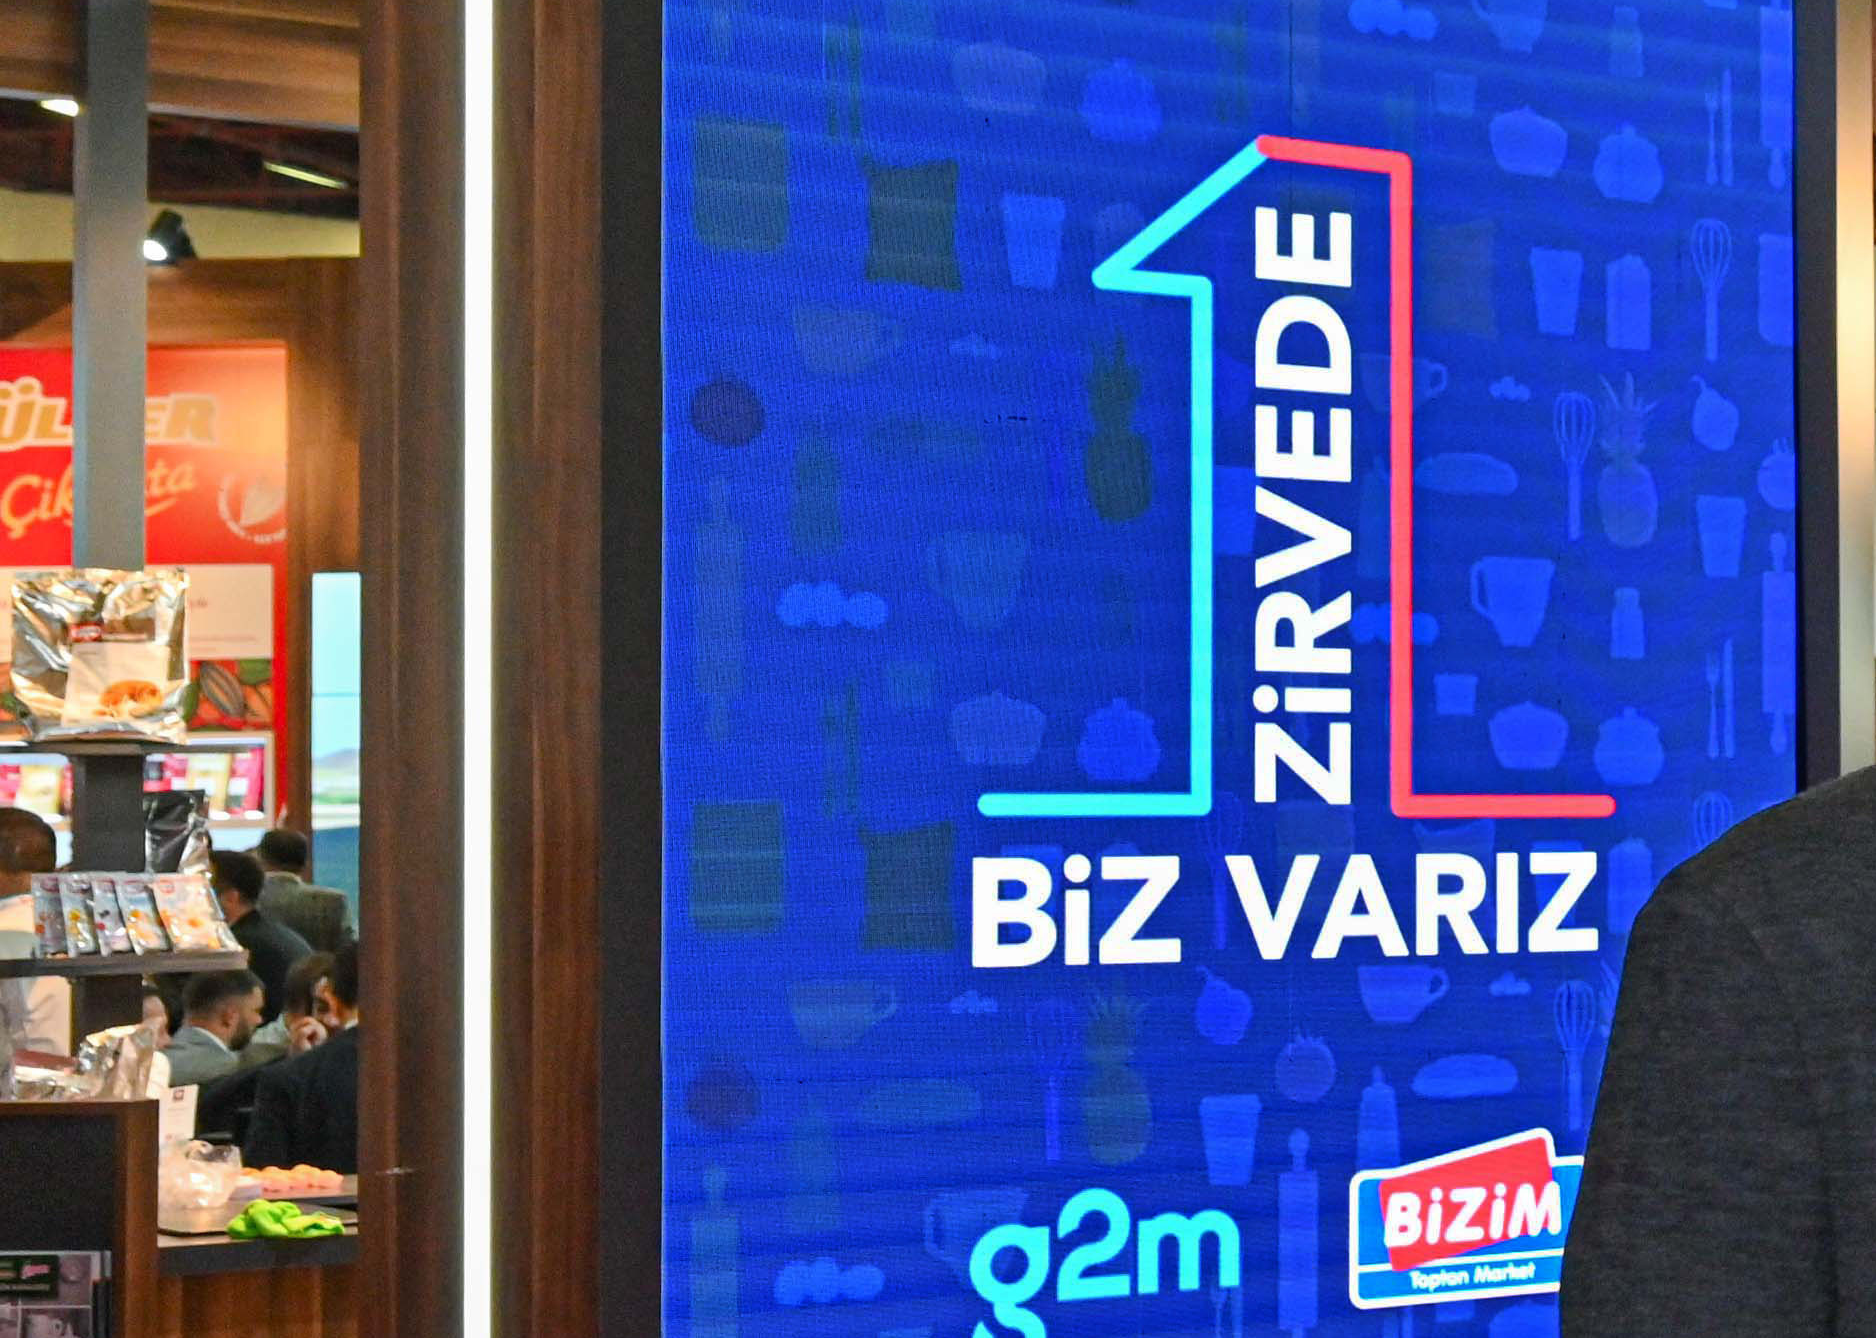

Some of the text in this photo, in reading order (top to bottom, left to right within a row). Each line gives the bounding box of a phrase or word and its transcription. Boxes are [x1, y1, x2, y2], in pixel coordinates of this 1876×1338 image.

[1224, 850, 1600, 961] VARIZ
[1409, 1261, 1536, 1293] Toptan Market
